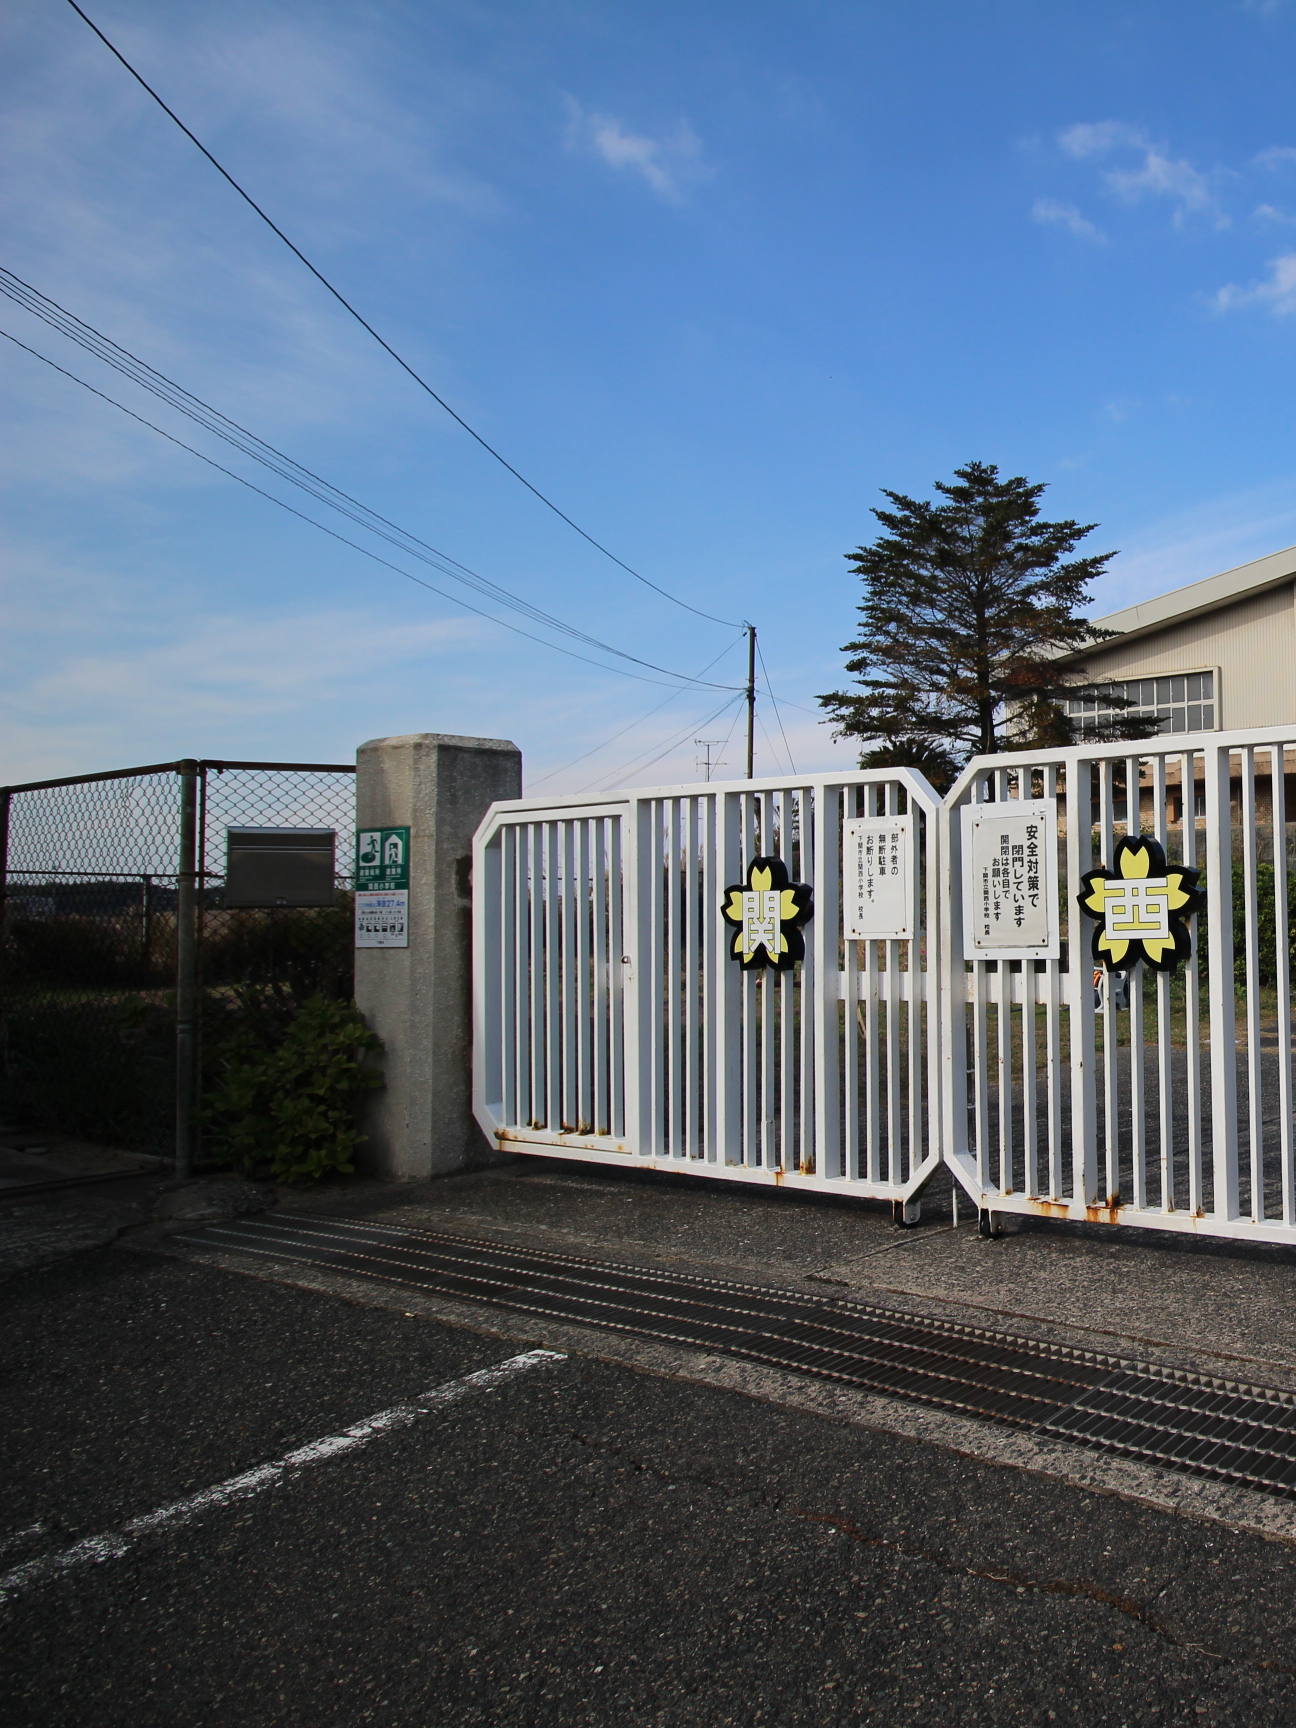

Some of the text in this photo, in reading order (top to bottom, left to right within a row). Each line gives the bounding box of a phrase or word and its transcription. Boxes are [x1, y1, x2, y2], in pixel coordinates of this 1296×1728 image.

[866, 834, 875, 904] お断りします。
[878, 833, 887, 876] 無断駐車
[890, 832, 899, 876] 部外者の
[1000, 834, 1011, 900] 開閉は各自で
[1011, 844, 1025, 928] 閉門しています
[1026, 824, 1040, 908] 安全対策で
[742, 890, 781, 954] 関
[992, 857, 1001, 922] お願いします
